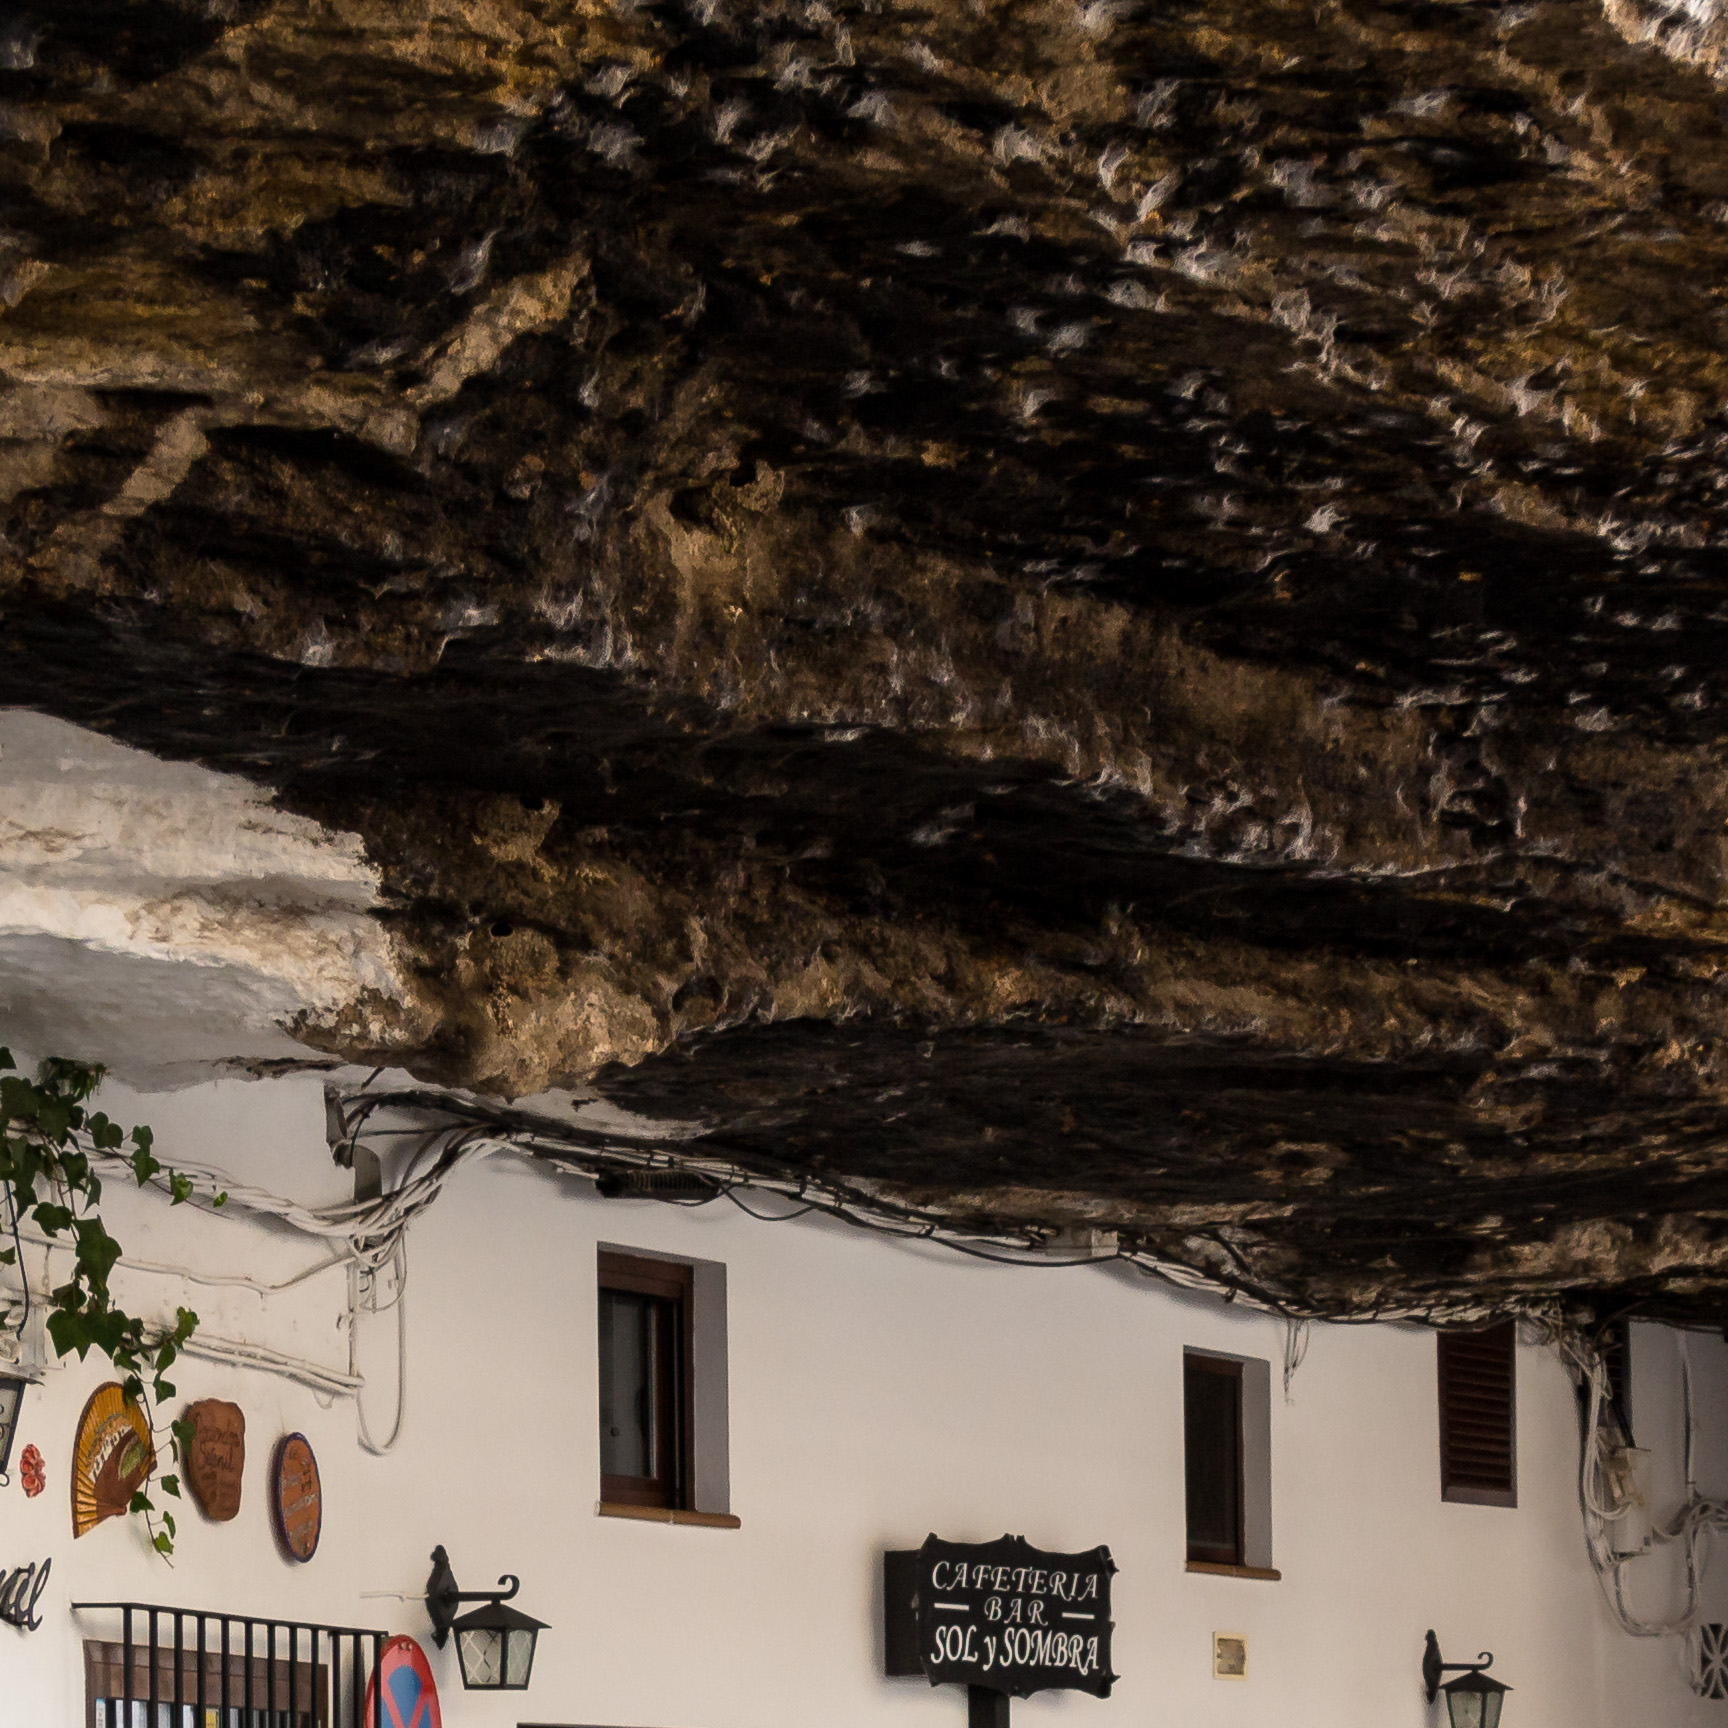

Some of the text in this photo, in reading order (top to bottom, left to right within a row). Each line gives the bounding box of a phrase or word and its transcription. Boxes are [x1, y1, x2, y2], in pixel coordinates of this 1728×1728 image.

[932, 1561, 1099, 1602] CAFETERIA
[984, 1596, 1049, 1627] BAR
[930, 1625, 1100, 1676] SOL y SOMBRA
